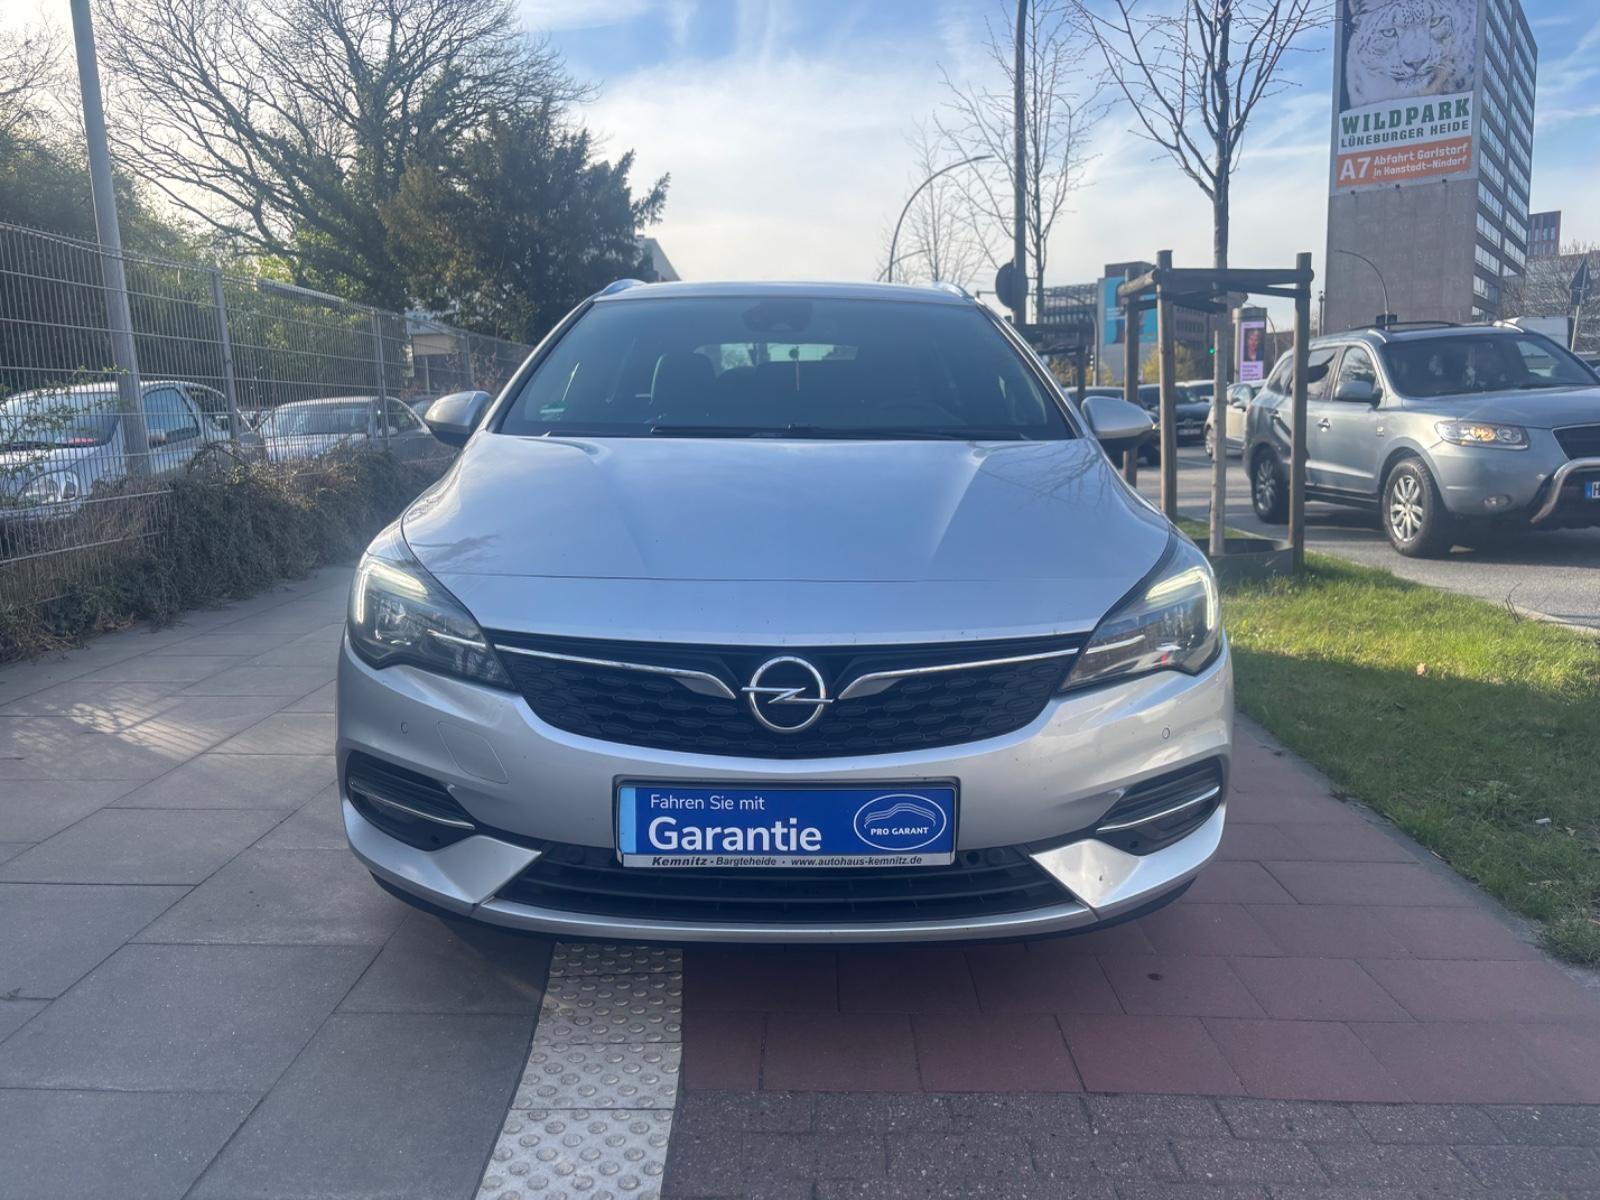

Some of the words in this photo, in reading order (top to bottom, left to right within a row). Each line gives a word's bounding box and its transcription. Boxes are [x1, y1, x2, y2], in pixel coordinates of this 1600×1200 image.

[1342, 98, 1470, 135] WILDPARK
[1341, 127, 1424, 148] LÜNEBURGER
[1430, 119, 1469, 136] HEIDE
[1374, 152, 1415, 166] Abfahrt
[1417, 142, 1468, 160] Garlstorf
[1339, 156, 1371, 181] A7
[1374, 167, 1381, 177] in
[650, 794, 704, 810] Fahren
[710, 795, 734, 810] Sie
[740, 796, 765, 810] mit
[648, 816, 822, 851] Garantie
[870, 827, 890, 836] PRO
[892, 827, 929, 836] GARANT
[652, 856, 708, 866] Kemnitz
[716, 856, 777, 867] Bargteheide
[791, 856, 922, 866] www.autohaus-kemnitz.de
